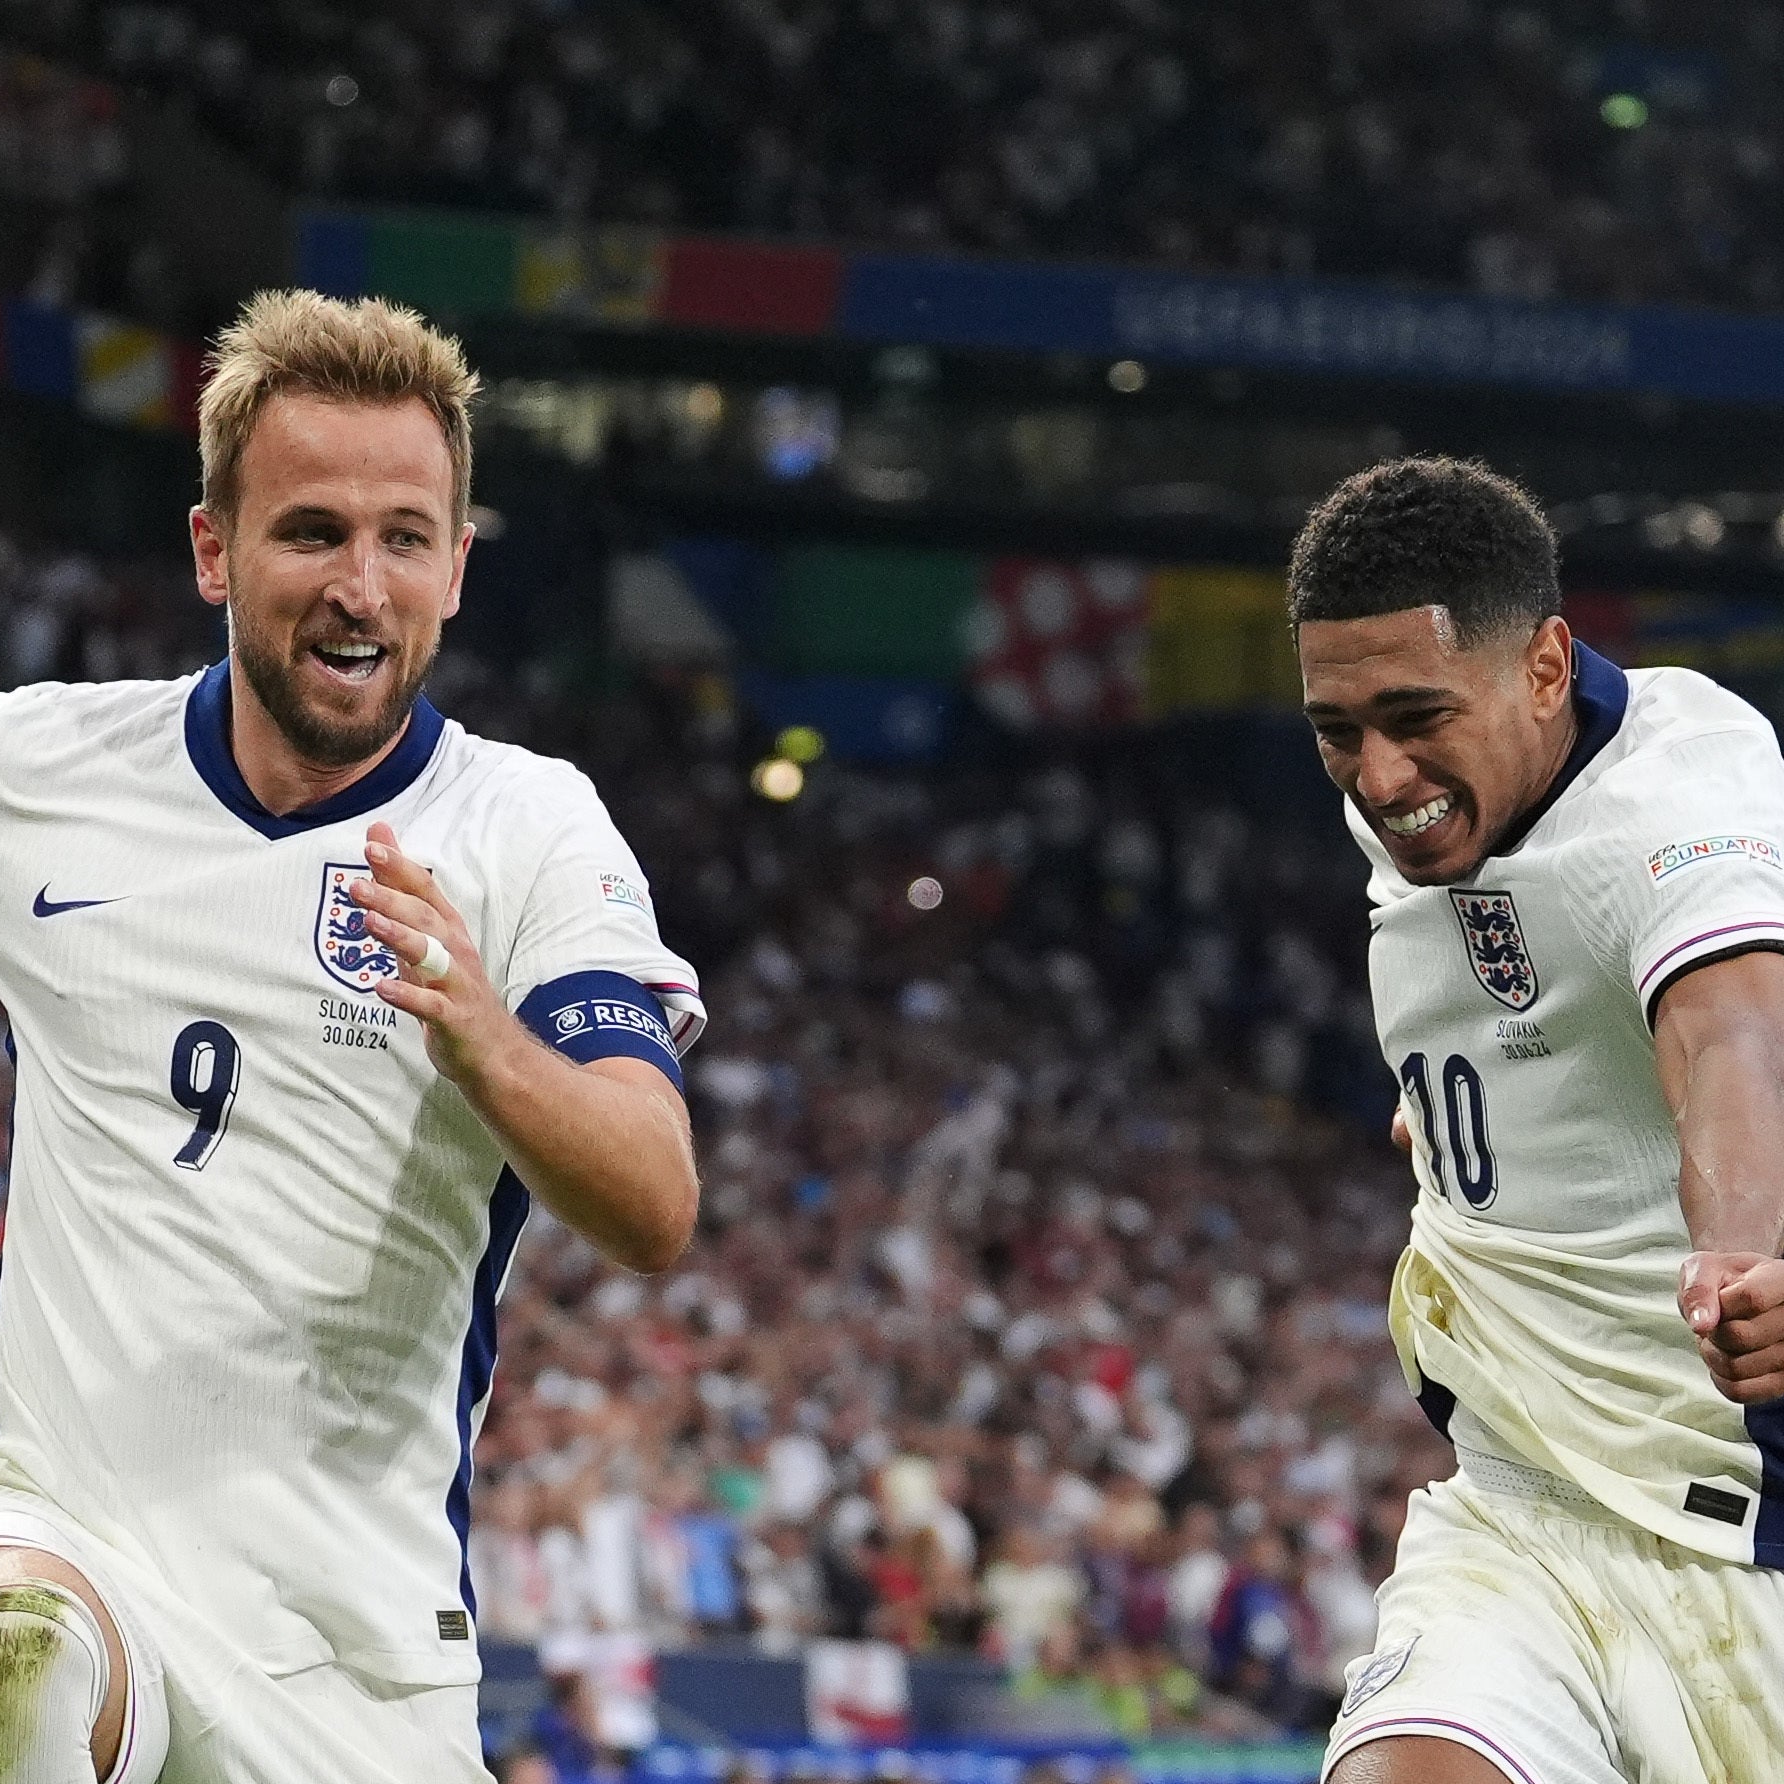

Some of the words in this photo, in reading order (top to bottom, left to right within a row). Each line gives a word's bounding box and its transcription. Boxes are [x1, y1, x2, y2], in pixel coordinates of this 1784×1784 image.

[1649, 844, 1677, 864] UEFA
[1651, 839, 1782, 877] FOUNDATION
[600, 873, 625, 884] UEFA
[319, 999, 397, 1028] SLOVAKIA
[323, 1025, 388, 1050] 30.06.24
[171, 1020, 242, 1172] 9
[1400, 1052, 1498, 1211] 10
